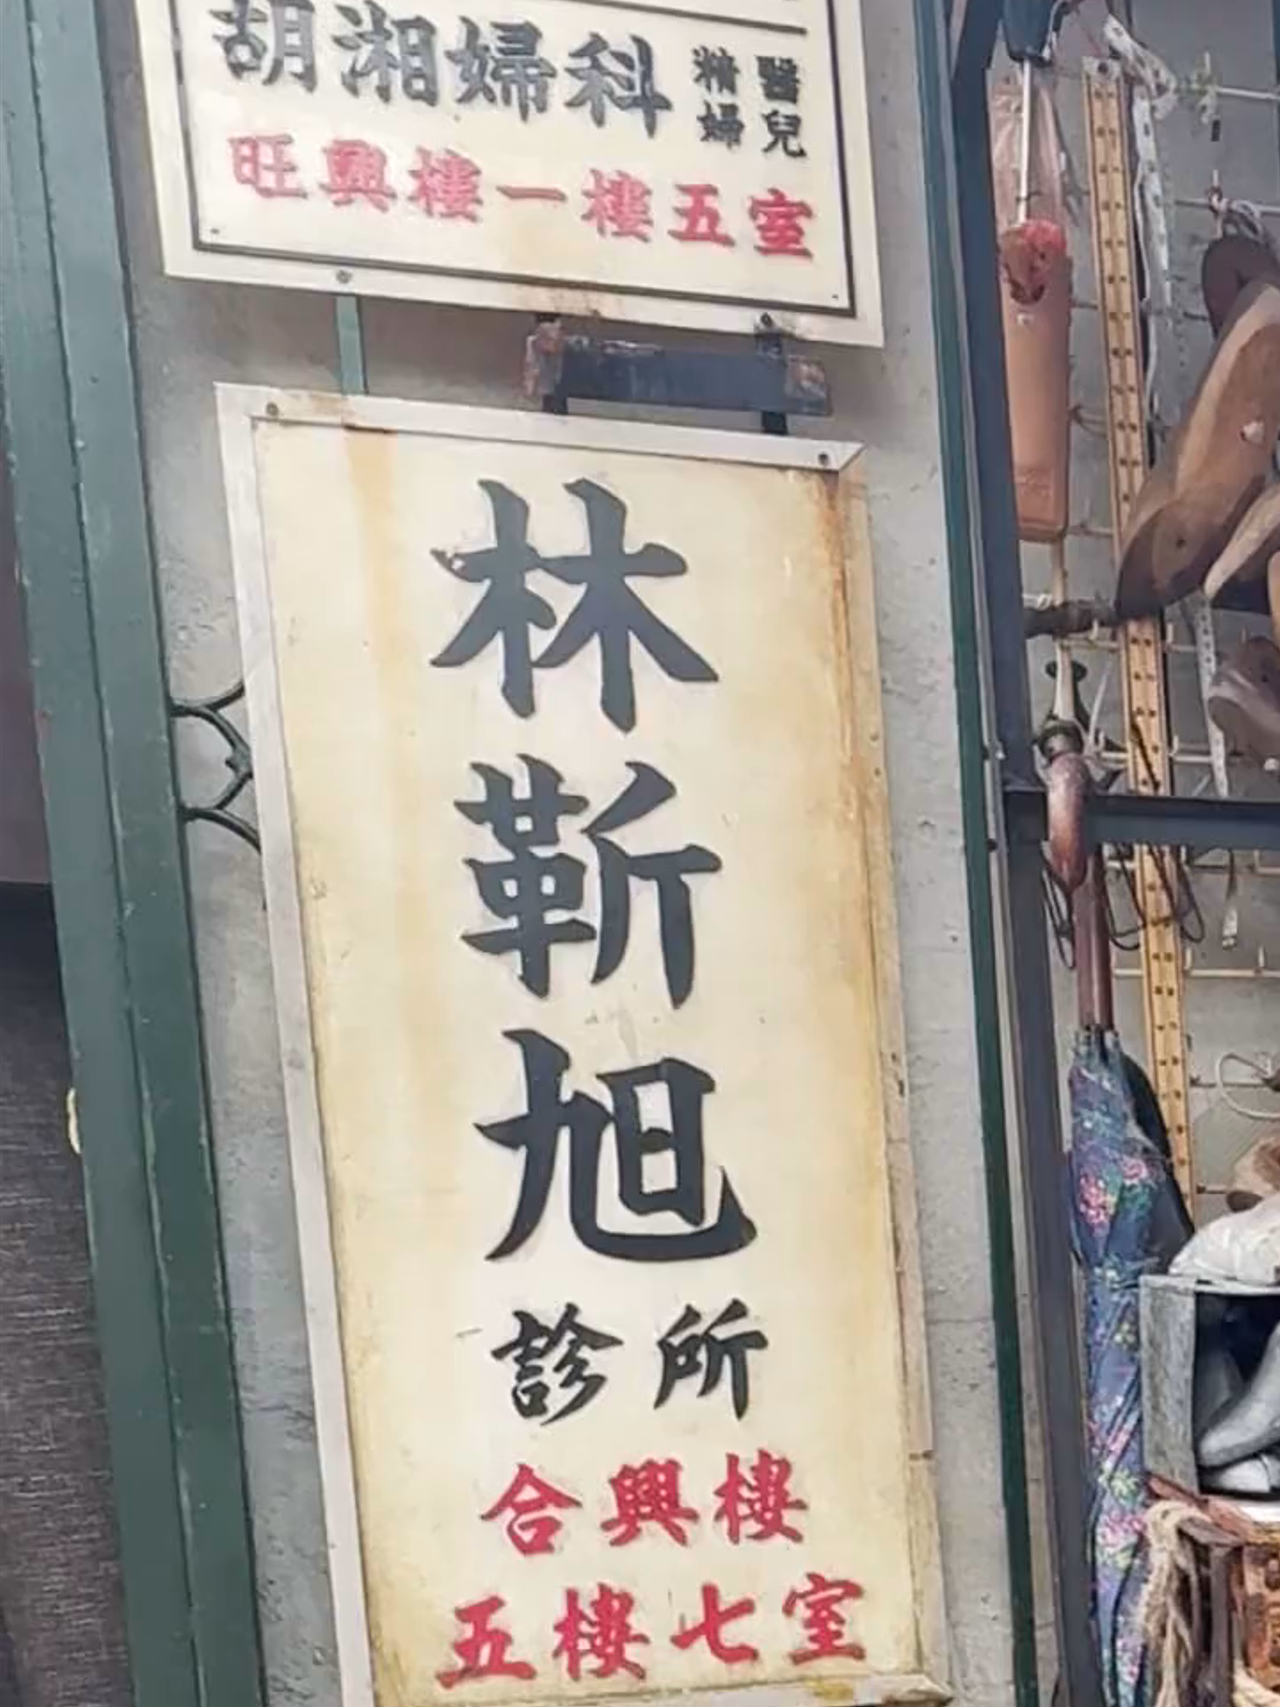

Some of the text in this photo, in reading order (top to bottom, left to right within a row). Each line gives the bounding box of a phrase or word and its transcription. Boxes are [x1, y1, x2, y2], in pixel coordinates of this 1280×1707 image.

[490, 1298, 770, 1426] 診所
[481, 1449, 809, 1556] 合興樓
[436, 1571, 868, 1691] 五樓七室
